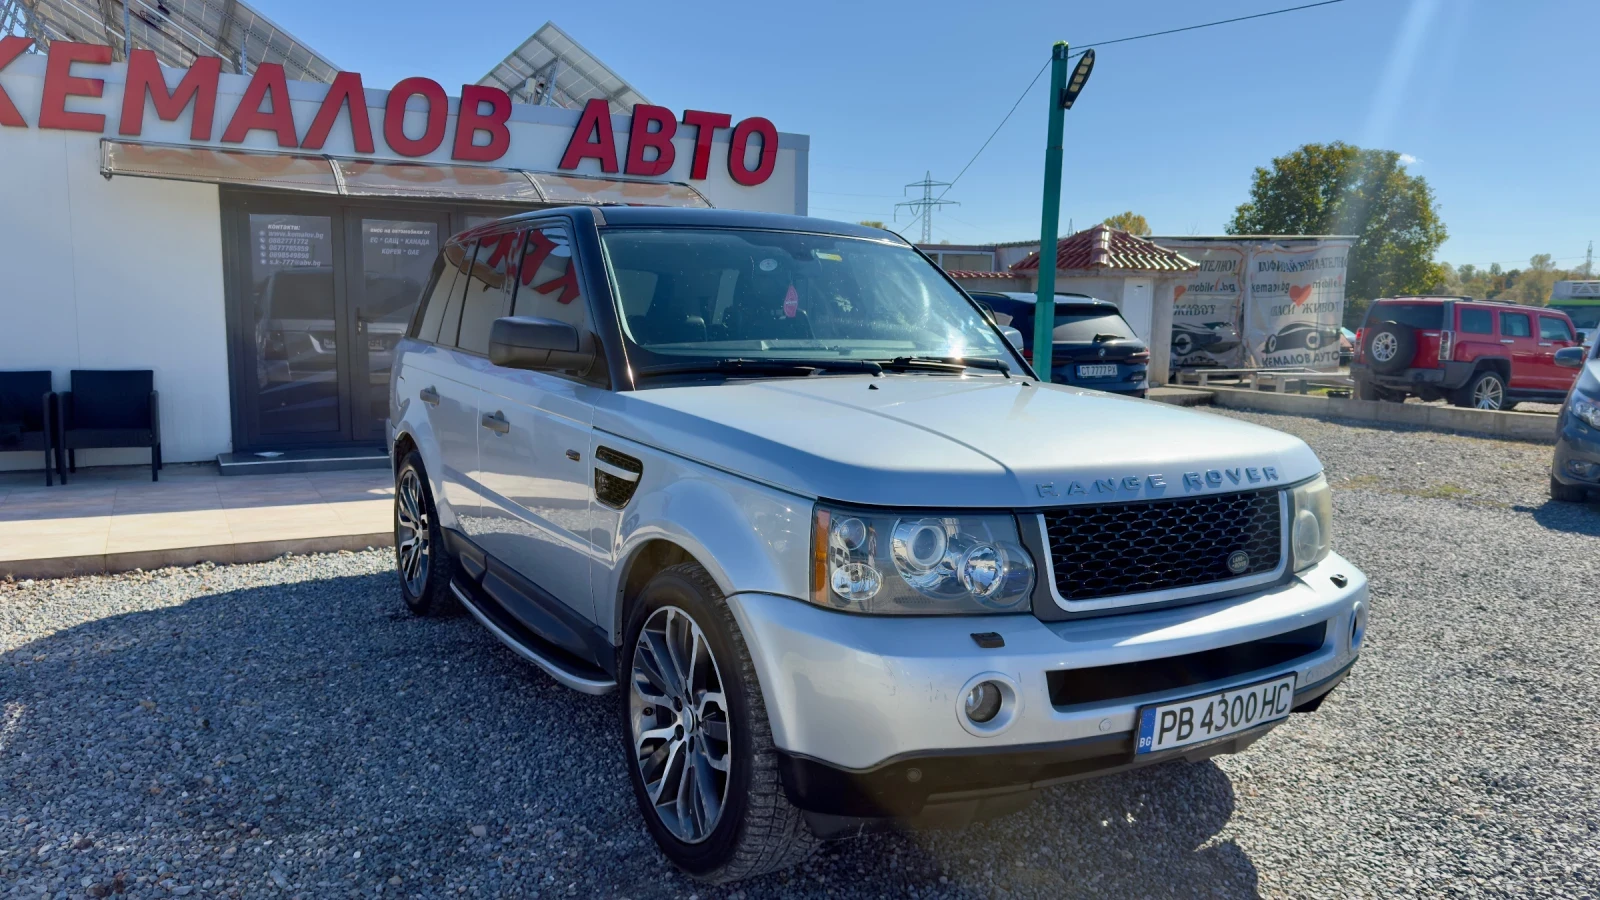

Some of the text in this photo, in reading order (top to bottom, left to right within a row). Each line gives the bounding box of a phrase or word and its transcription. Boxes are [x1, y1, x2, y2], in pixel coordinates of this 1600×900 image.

[557, 98, 779, 187] АВТО
[404, 238, 430, 246] КАНАДА
[1302, 301, 1340, 314] ЖИВОТ
[1313, 350, 1340, 363] АУТО
[1091, 366, 1107, 375] 7777
[1036, 466, 1280, 498] RANGE ROVER
[1157, 682, 1290, 745] PB 4300 HC
[1139, 736, 1152, 748] BG
